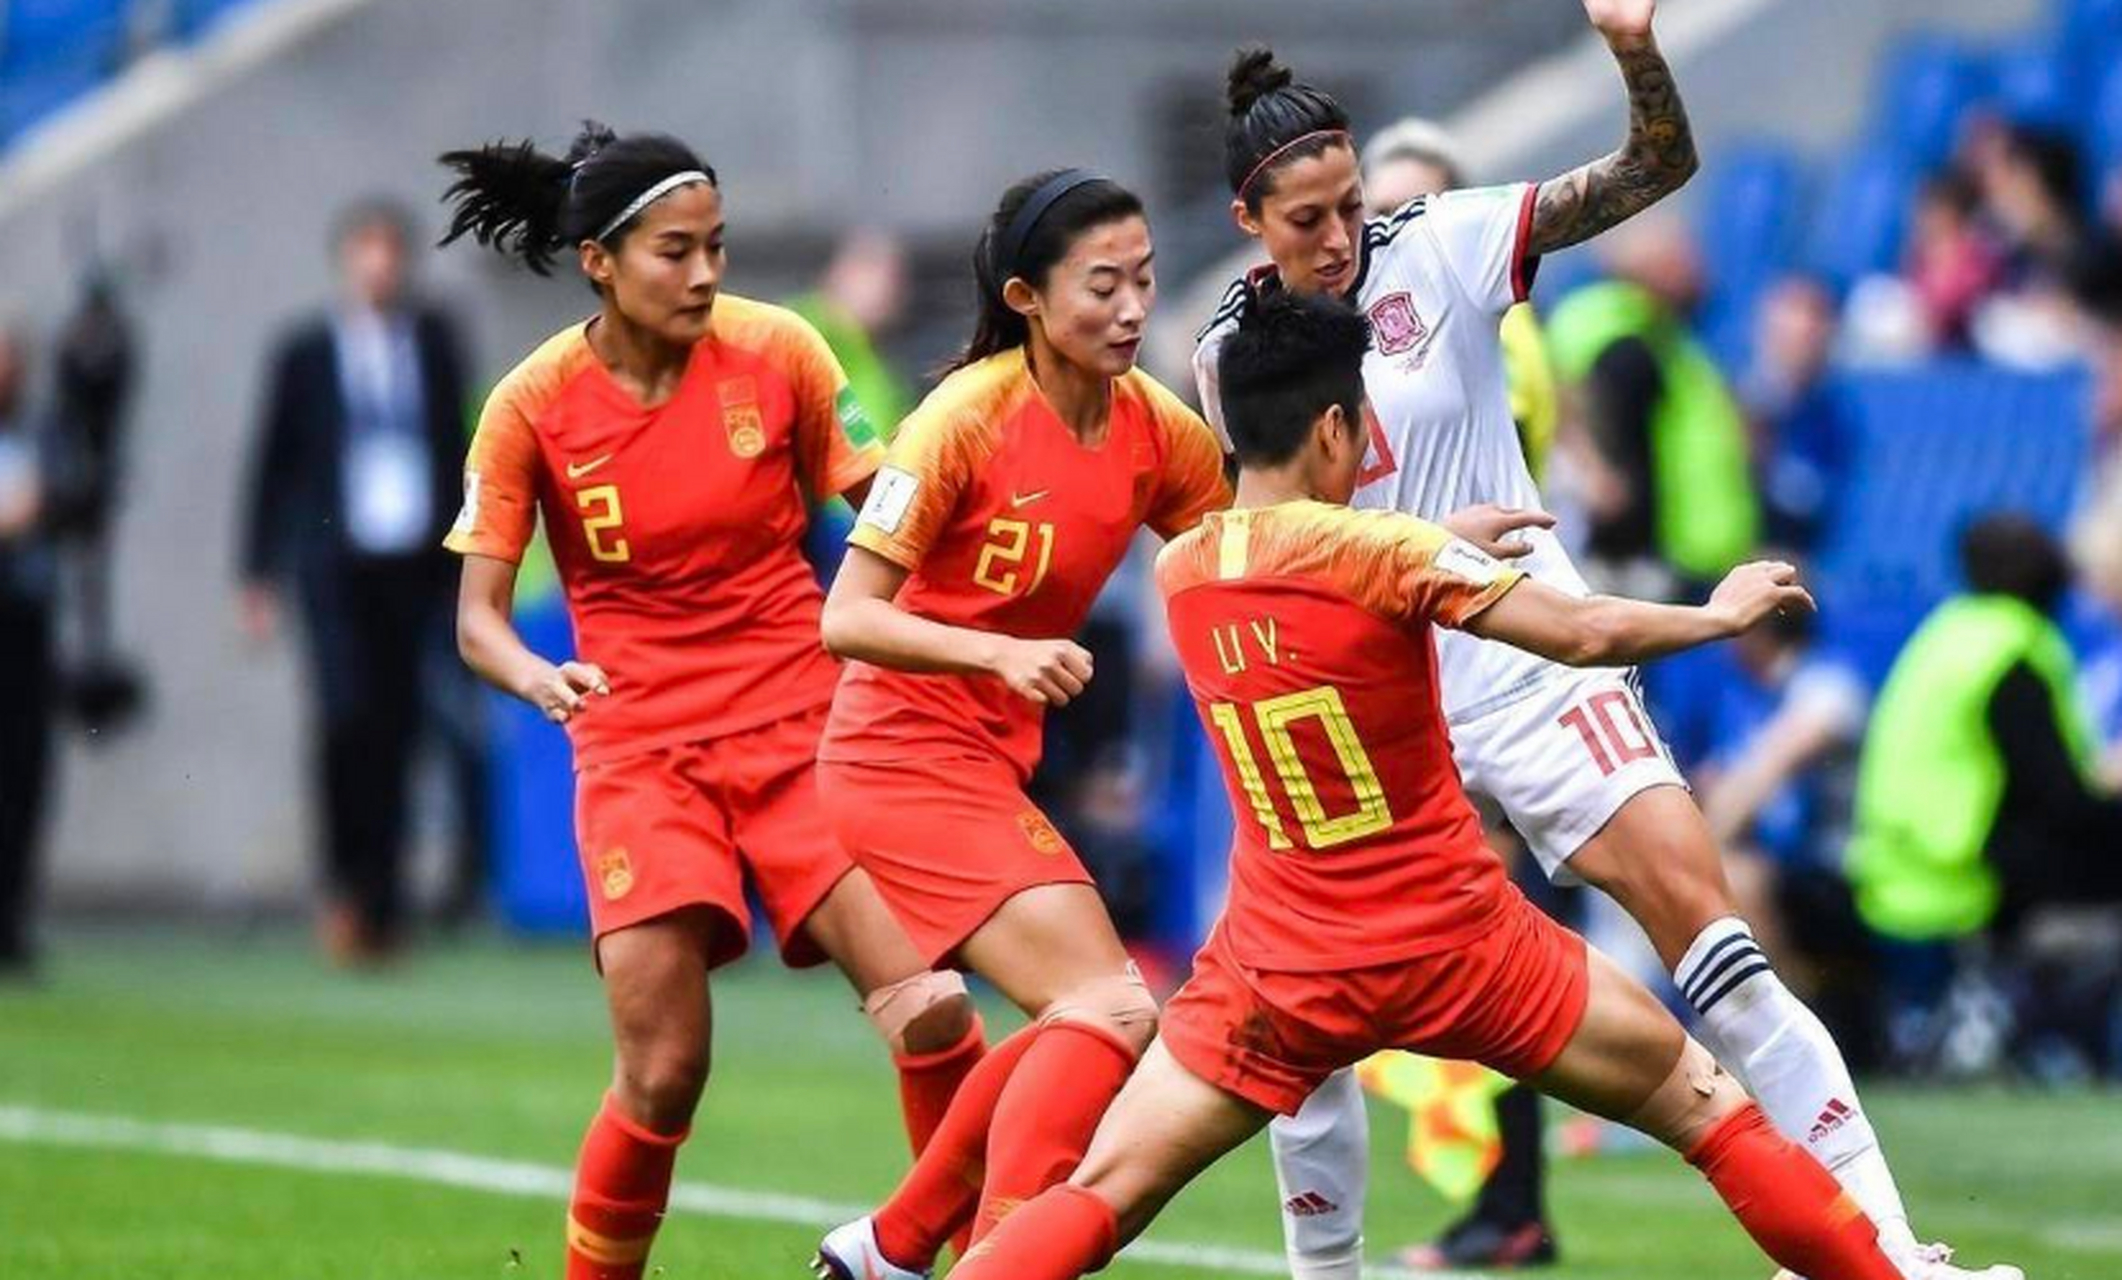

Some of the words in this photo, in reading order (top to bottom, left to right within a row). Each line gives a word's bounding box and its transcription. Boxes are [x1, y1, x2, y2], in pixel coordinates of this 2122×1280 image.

[577, 485, 630, 562] 2
[973, 518, 1055, 597] 21
[1212, 624, 1245, 674] LI
[1211, 686, 1393, 849] 10
[1558, 690, 1659, 777] 10
